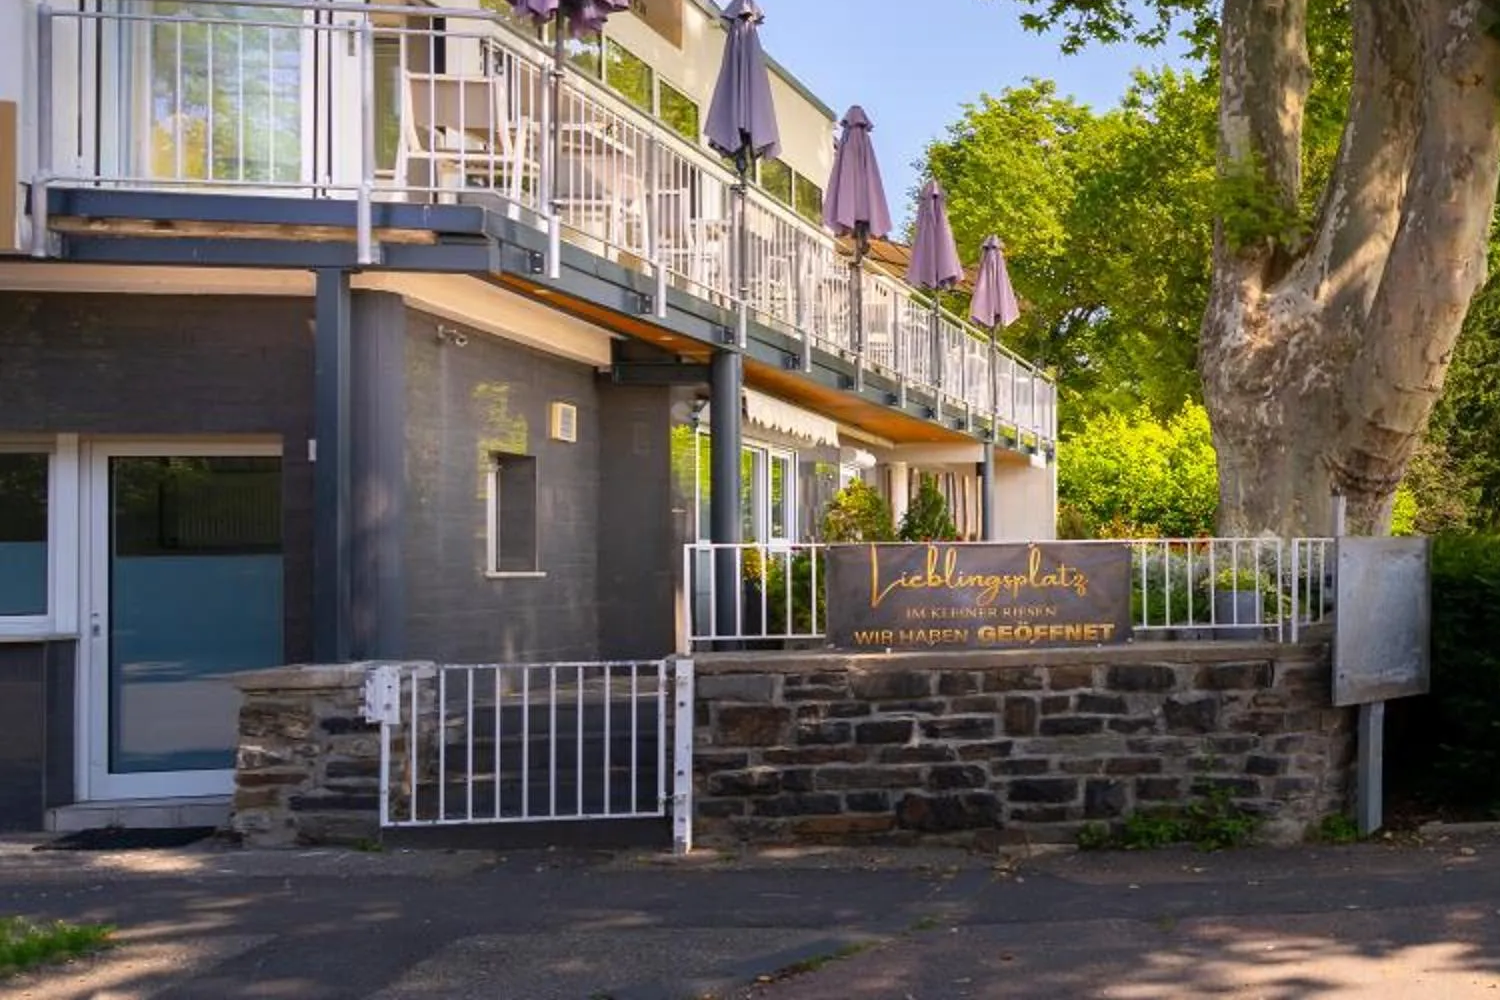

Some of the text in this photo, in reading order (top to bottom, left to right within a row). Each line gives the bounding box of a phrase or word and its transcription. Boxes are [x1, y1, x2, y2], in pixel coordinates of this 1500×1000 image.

[871, 543, 1089, 608] Lieblingsplatz
[906, 607, 926, 618] IM
[1003, 605, 1057, 617] RIESEN
[854, 620, 1115, 645] WIR HABEN GEÖFFNET
